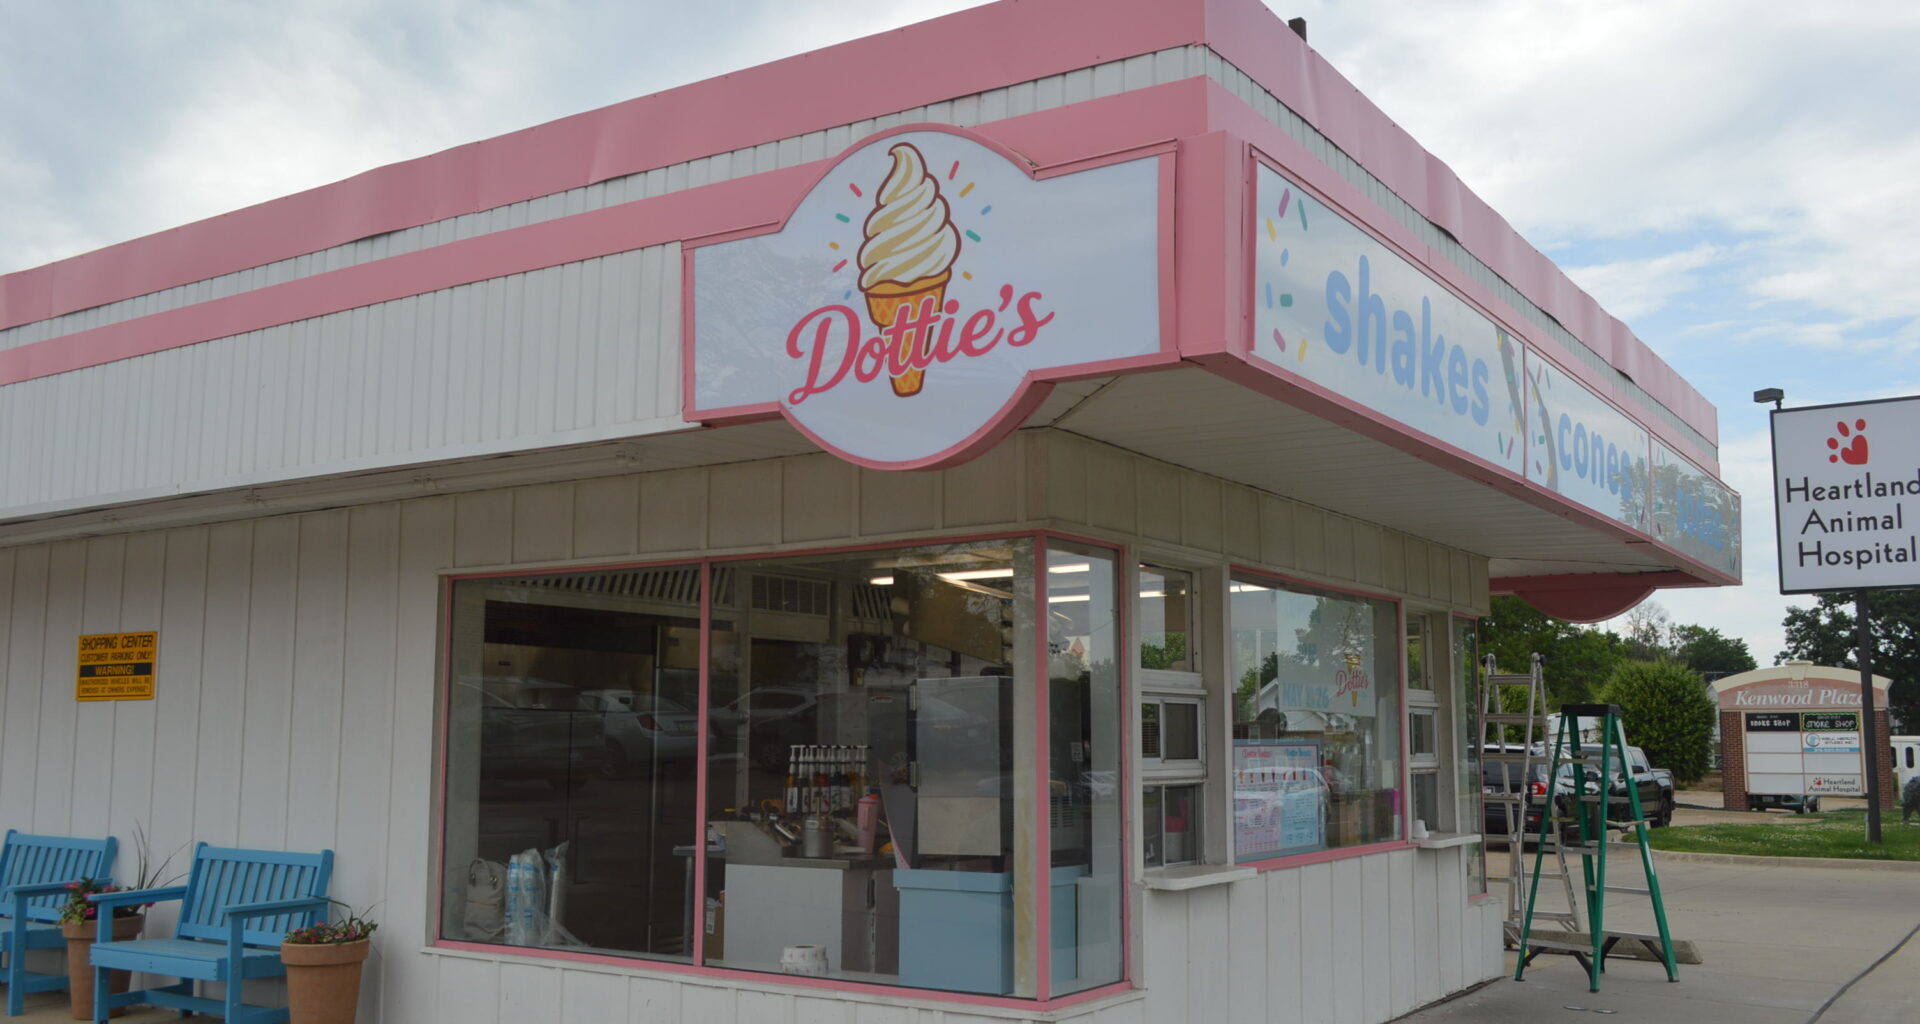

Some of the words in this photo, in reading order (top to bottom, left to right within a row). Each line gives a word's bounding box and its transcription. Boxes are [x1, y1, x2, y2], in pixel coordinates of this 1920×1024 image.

[786, 284, 1055, 405] Dottie's
[1324, 254, 1489, 427] shakes
[1558, 413, 1633, 501] cones
[1785, 468, 1920, 503] Heartland
[1801, 503, 1902, 535] Animal
[1798, 535, 1917, 570] Hospital
[81, 636, 118, 650] SHOPPING
[121, 635, 153, 648] CENTER
[1735, 689, 1813, 706] Kenwood
[1806, 720, 1831, 728] SMOKE
[1834, 720, 1855, 728] SHOP
[1808, 784, 1832, 792] Animal
[1833, 784, 1860, 793] Hospital
[1824, 777, 1855, 785] Heartland
